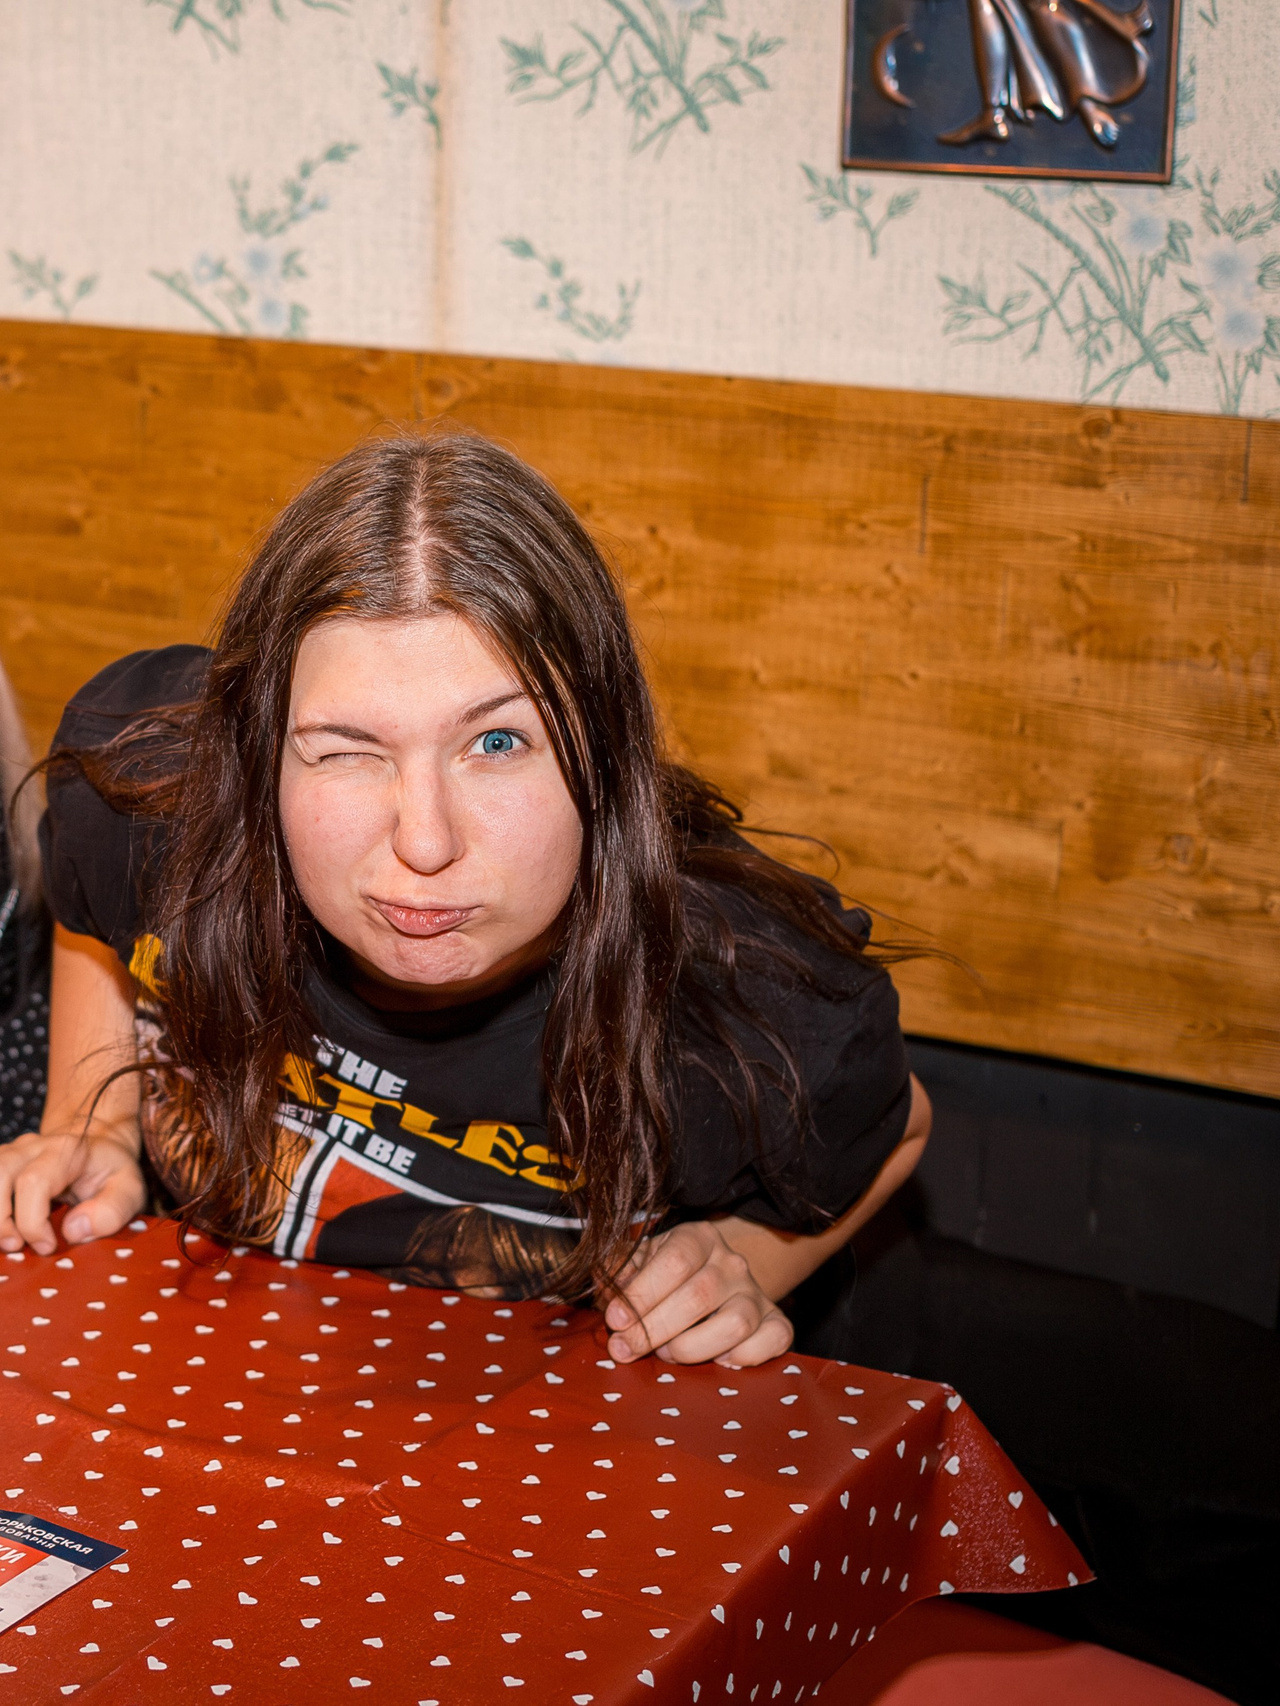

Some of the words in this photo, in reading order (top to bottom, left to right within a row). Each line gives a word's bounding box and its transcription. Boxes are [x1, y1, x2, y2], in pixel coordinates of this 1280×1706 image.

[312, 1034, 408, 1099] THE
[277, 1102, 323, 1124] ET
[326, 1113, 366, 1146] IT
[363, 1133, 417, 1175] BE
